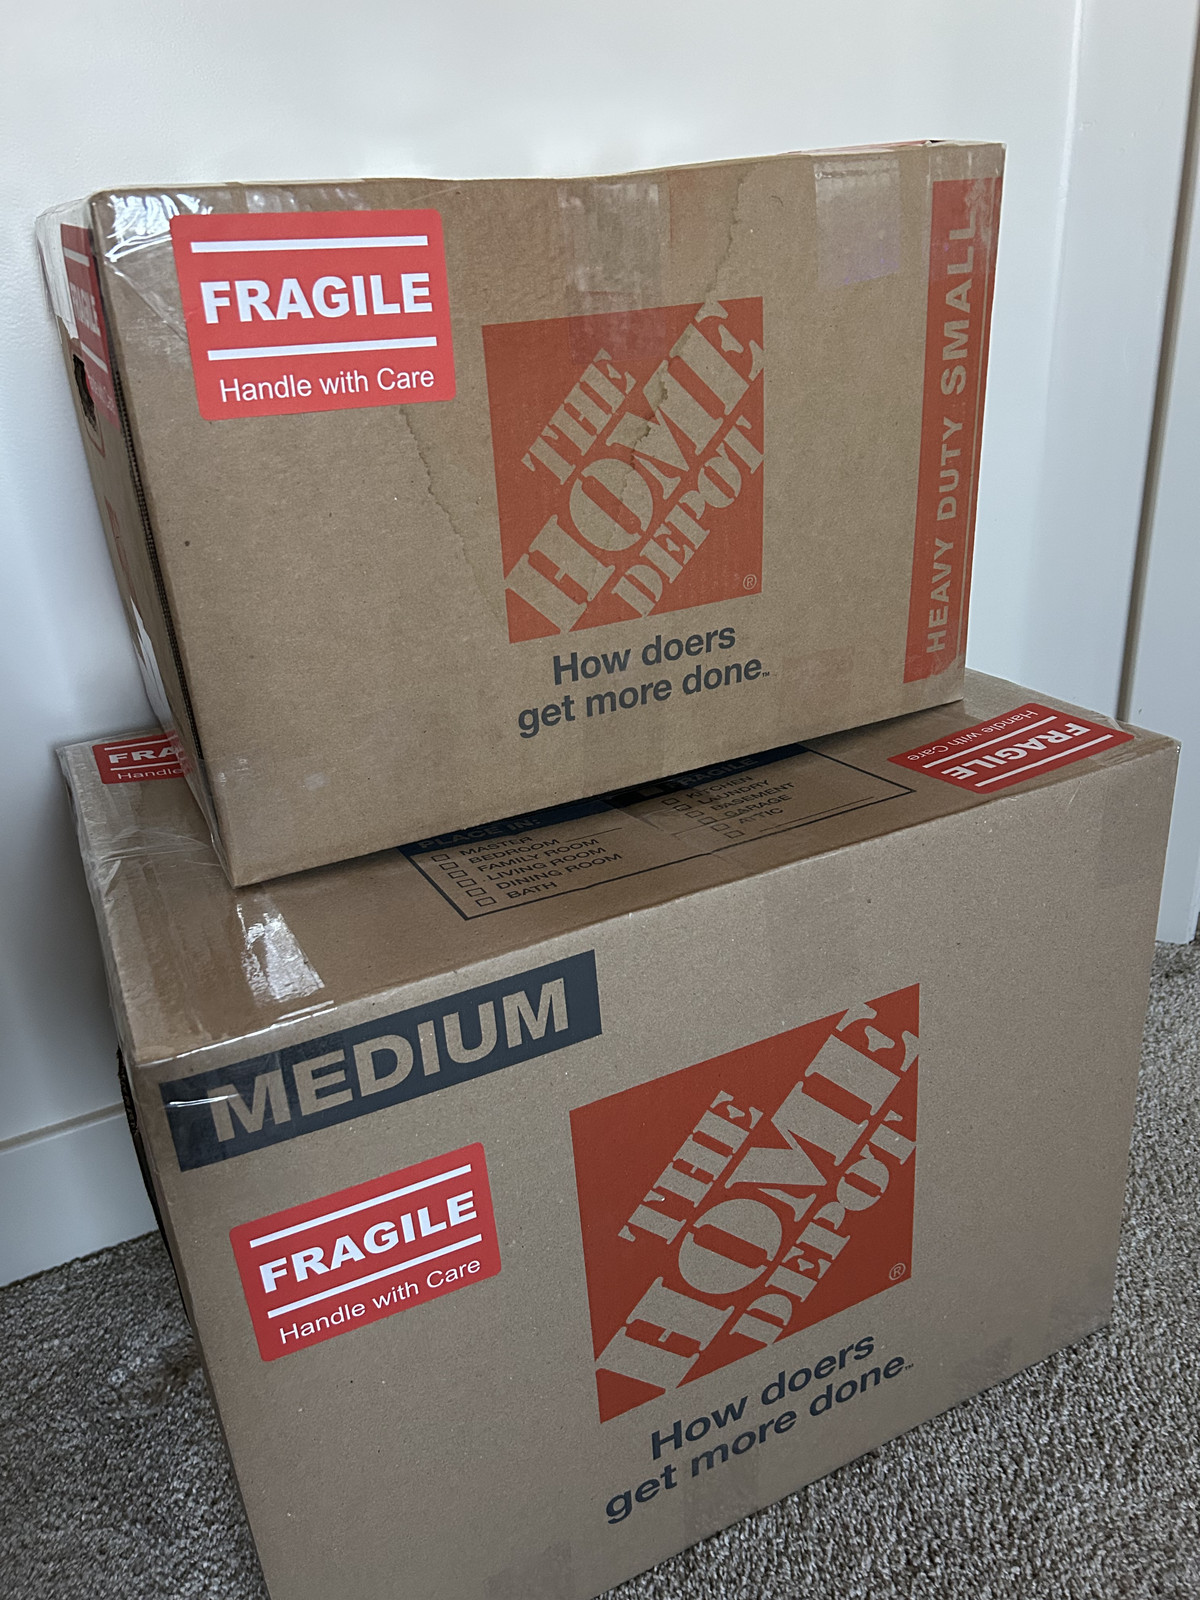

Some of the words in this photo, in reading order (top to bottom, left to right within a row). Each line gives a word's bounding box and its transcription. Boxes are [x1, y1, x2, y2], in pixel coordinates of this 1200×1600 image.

[200, 272, 434, 325] FRAGILE
[940, 208, 978, 395] SMALL
[219, 374, 313, 403] Handle
[319, 370, 369, 395] with
[377, 367, 435, 391] Care
[520, 348, 637, 485] THE
[503, 300, 764, 632] HOME
[936, 416, 964, 520] DUTY
[611, 415, 764, 617] DEPOT
[926, 538, 954, 653] HEAVY
[553, 648, 631, 685] How
[641, 627, 736, 666] doers
[518, 695, 576, 739] get
[586, 679, 673, 717] more
[980, 709, 1039, 734] Handle
[907, 744, 950, 762] Care
[940, 722, 1092, 780] FRAGILE
[947, 730, 983, 748] with
[686, 776, 754, 799] KITCHEN
[698, 779, 770, 805] LAUNDRY
[709, 782, 796, 811] BASEMENT
[723, 794, 793, 818] GARAGE
[417, 824, 502, 849] PLACE
[504, 816, 542, 832] IN:
[738, 806, 784, 825] ATTIC
[459, 836, 533, 856] MASTER
[467, 838, 560, 864] BEDROOM
[477, 853, 540, 872] FAMILY
[543, 838, 600, 857] ROOM
[487, 863, 548, 882] LIVING
[550, 847, 607, 866] ROOM
[495, 869, 563, 890] DINING
[565, 853, 623, 873] ROOM
[506, 881, 558, 899] BATH
[207, 977, 569, 1143] MEDIUM
[618, 1090, 764, 1245] THE
[595, 1002, 919, 1391] HOME
[259, 1190, 478, 1294] FRAGILE
[729, 1109, 917, 1345] DEPOT
[279, 1303, 366, 1345] Handle
[372, 1281, 420, 1309] with
[426, 1259, 481, 1289] Care
[651, 1395, 749, 1460] How
[761, 1336, 875, 1405] doers
[606, 1464, 678, 1524] get
[691, 1410, 797, 1478] more
